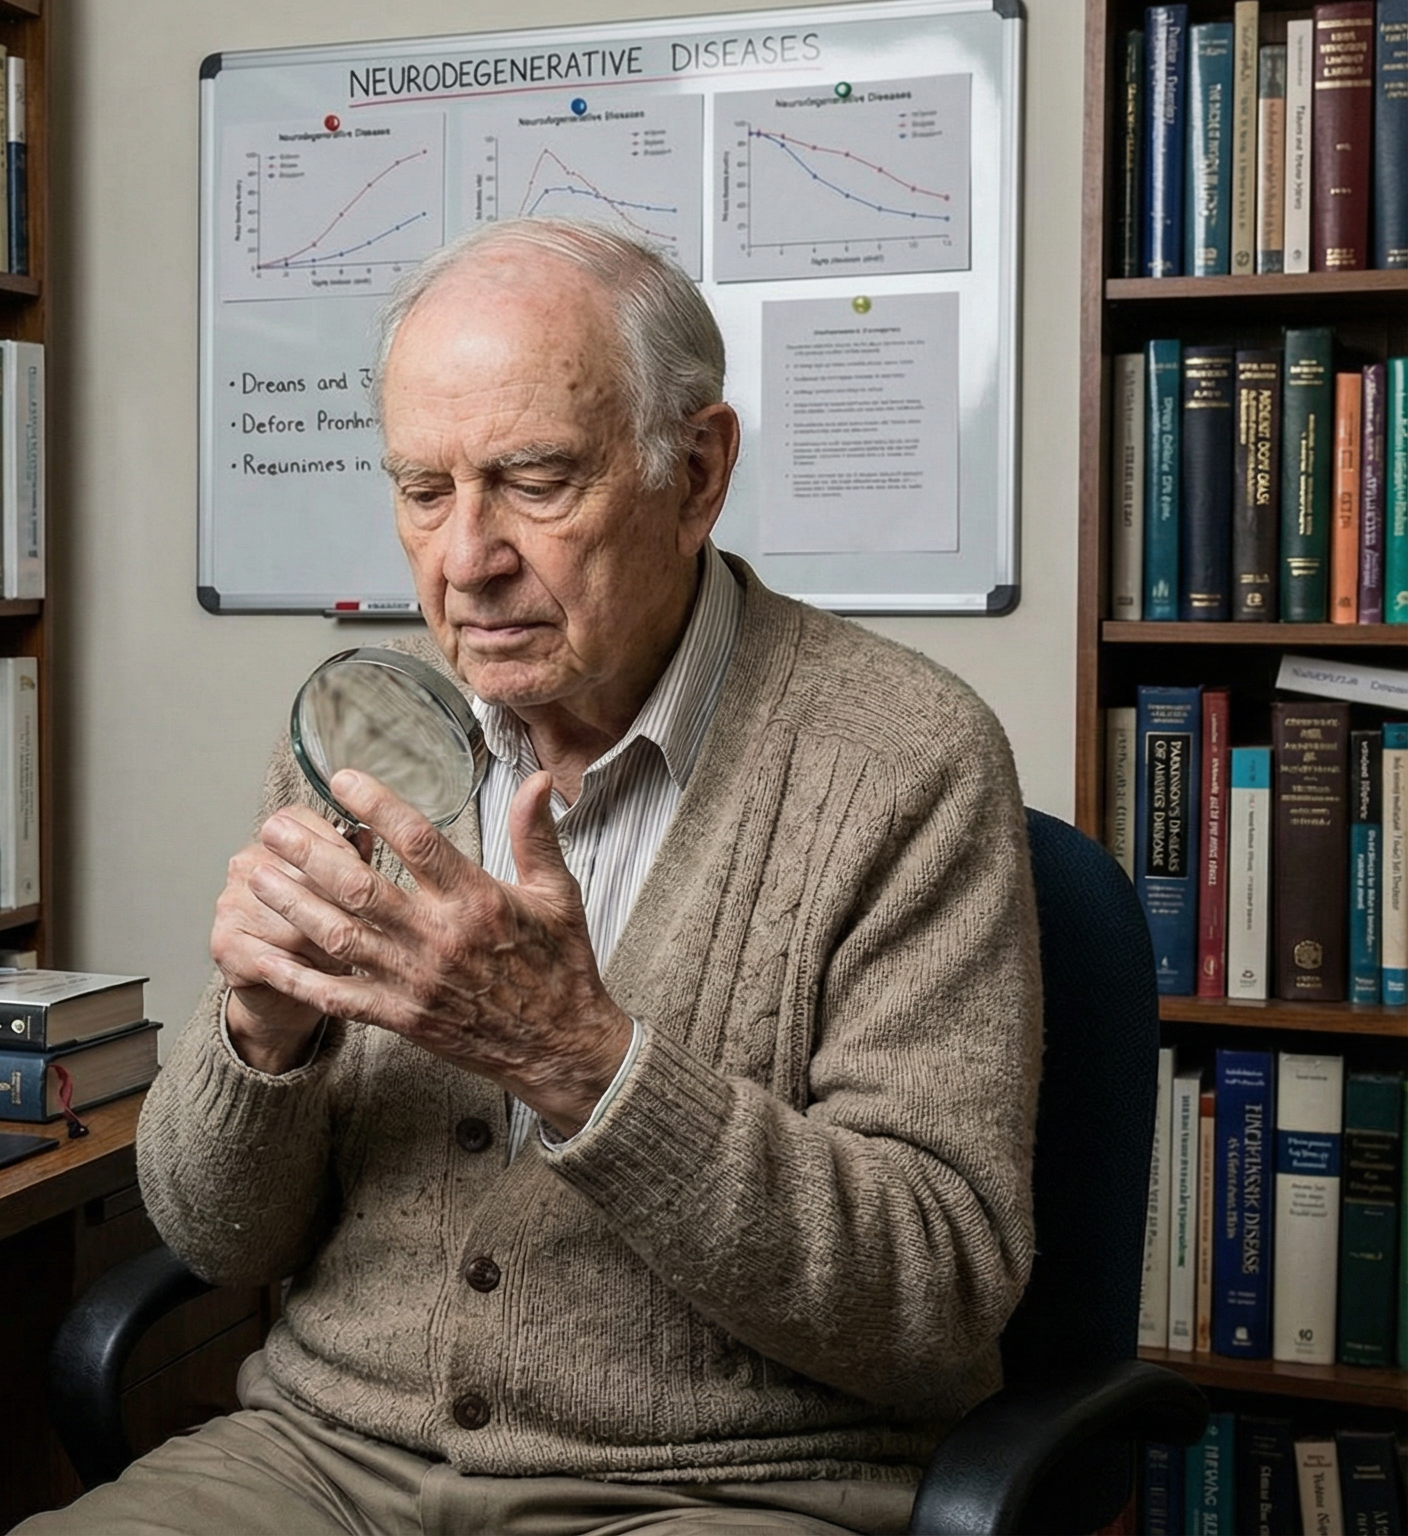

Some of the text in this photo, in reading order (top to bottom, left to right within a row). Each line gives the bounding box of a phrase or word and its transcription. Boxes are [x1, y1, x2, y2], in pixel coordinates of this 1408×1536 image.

[349, 32, 822, 98] NEURODEGENERATIVE DISEASES
[317, 371, 349, 391] and
[242, 412, 306, 434] Defore
[355, 456, 372, 471] in
